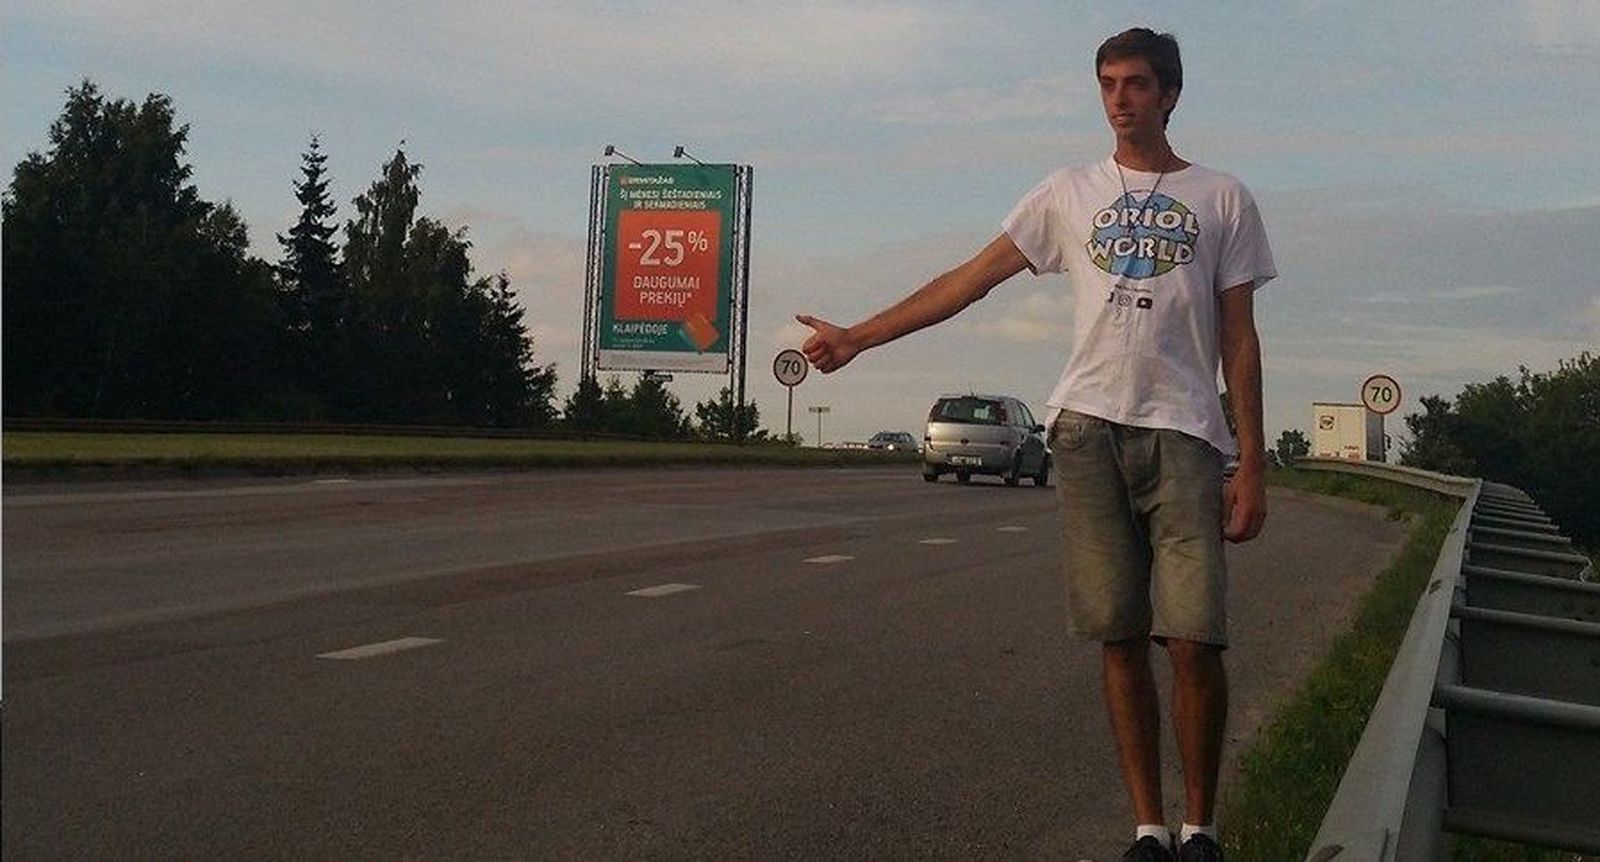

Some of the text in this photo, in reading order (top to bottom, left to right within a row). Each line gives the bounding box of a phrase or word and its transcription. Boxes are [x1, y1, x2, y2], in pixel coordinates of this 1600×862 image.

[1094, 207, 1199, 235] ORIOL
[1086, 237, 1195, 264] WORLD
[633, 276, 701, 290] DAUGUMAI
[781, 360, 800, 375] 70
[1371, 386, 1392, 403] 70
